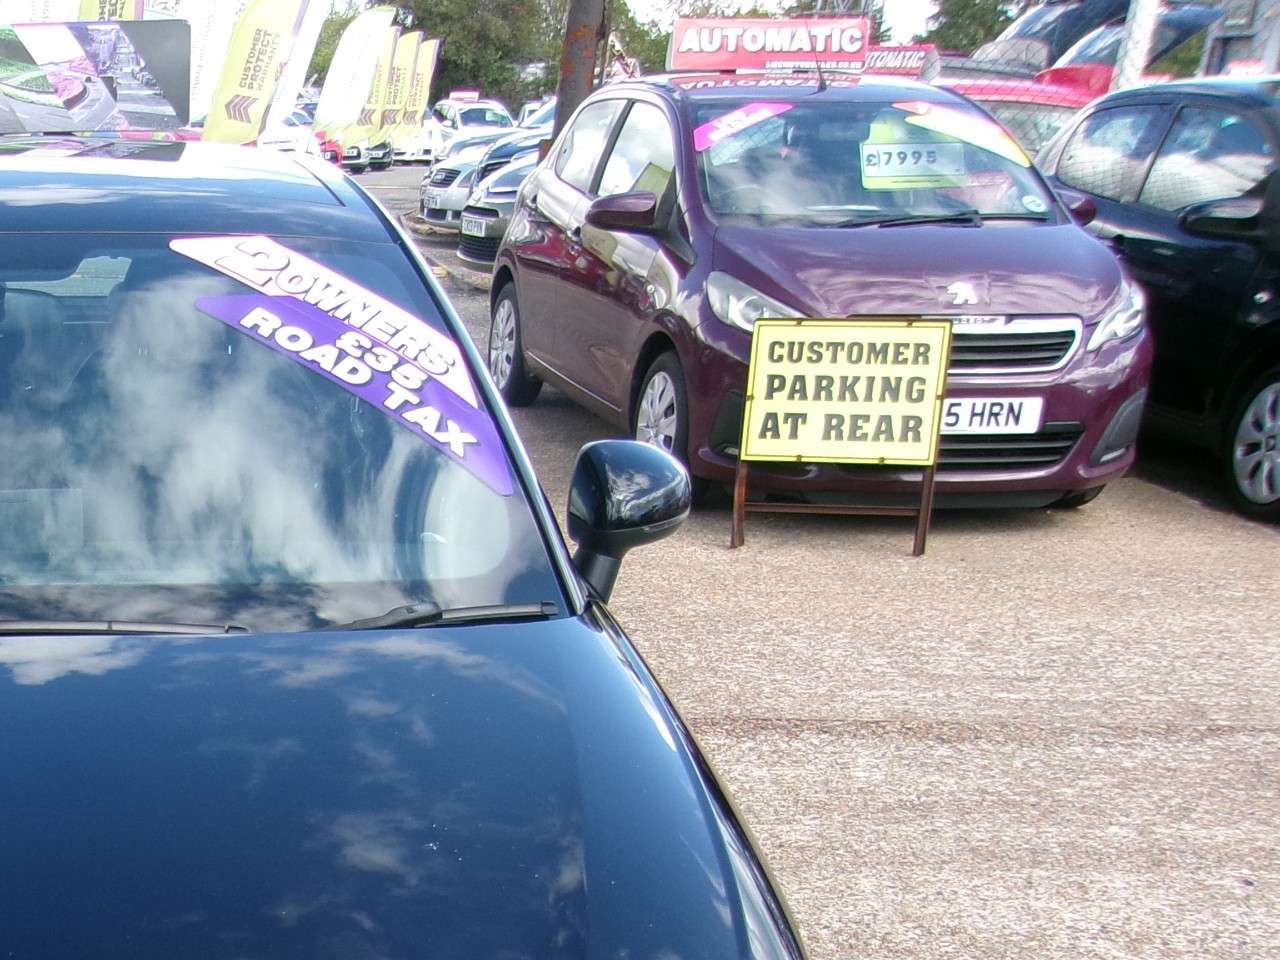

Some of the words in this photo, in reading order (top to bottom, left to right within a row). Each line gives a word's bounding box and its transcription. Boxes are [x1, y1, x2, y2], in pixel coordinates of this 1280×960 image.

[238, 28, 263, 88] CUSTOMER
[246, 29, 272, 90] PROTECT
[255, 32, 281, 92] WARRANTY
[679, 27, 863, 53] AUTOMATIC
[864, 149, 938, 168] £7995
[275, 267, 456, 376] OWNERS
[335, 330, 432, 391] £35
[768, 340, 931, 365] CUSTOMER
[238, 306, 374, 386] ROAD
[383, 381, 478, 458] TAX
[764, 373, 927, 404] PARKING
[758, 412, 808, 440] AT
[821, 413, 923, 443] REAR
[969, 402, 1024, 428] HRN
